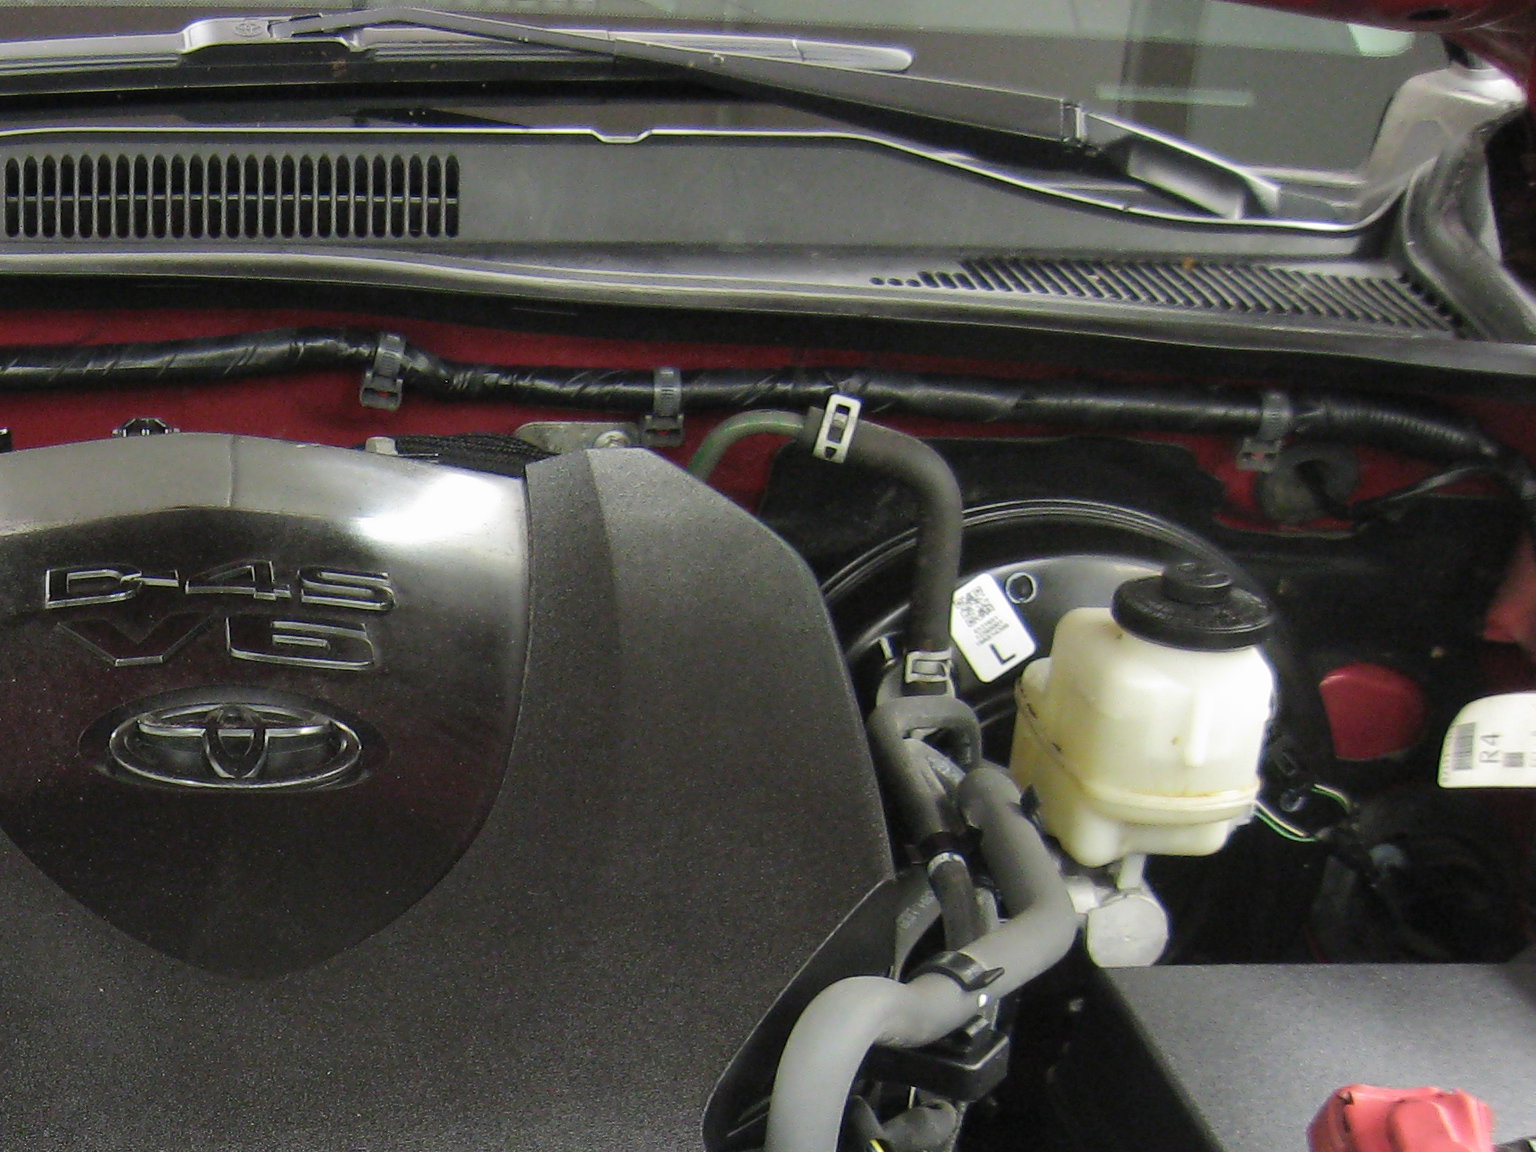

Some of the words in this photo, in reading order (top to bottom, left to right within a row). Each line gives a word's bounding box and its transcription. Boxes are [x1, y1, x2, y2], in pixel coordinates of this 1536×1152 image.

[44, 559, 396, 612] D-4S
[57, 613, 378, 671] V6
[989, 643, 1016, 665] L
